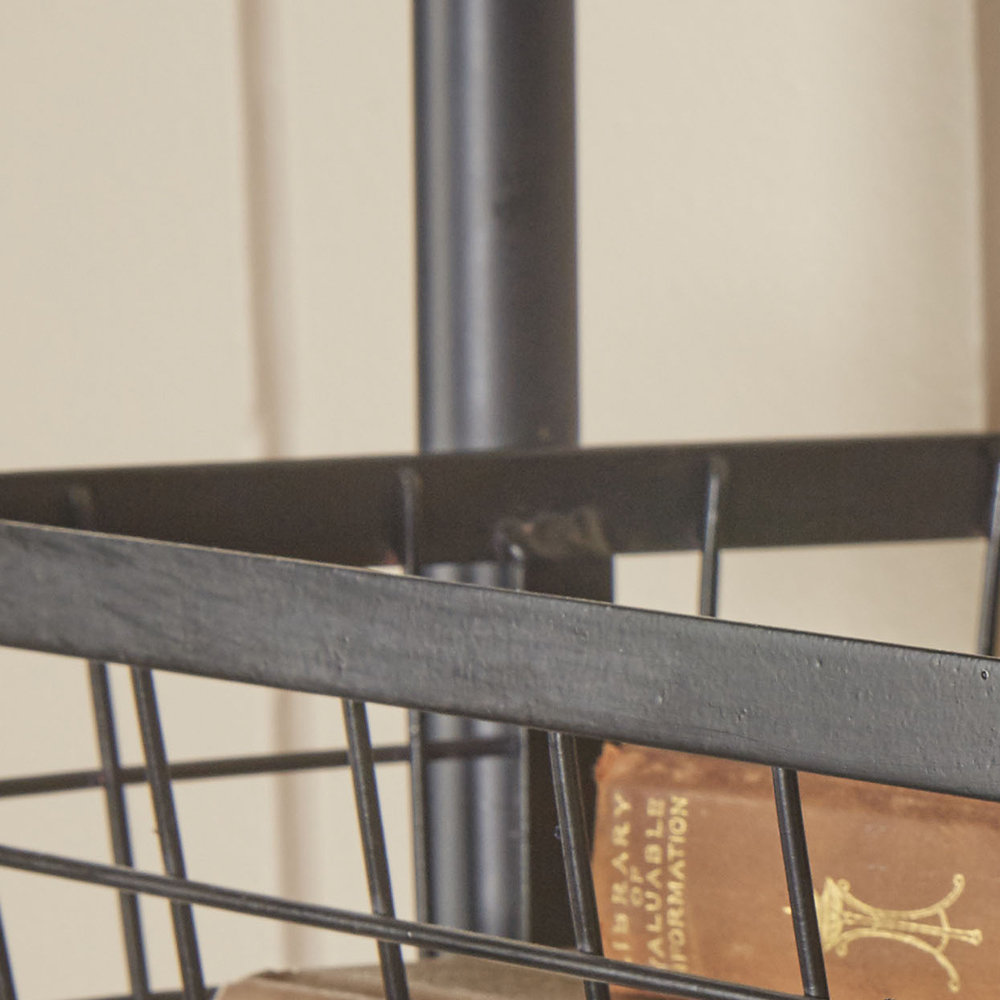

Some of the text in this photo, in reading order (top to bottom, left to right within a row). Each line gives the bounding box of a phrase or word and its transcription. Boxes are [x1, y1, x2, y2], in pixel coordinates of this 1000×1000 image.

[611, 789, 634, 963] IBRARY
[629, 865, 645, 908] OF
[666, 795, 689, 973] FORMATION
